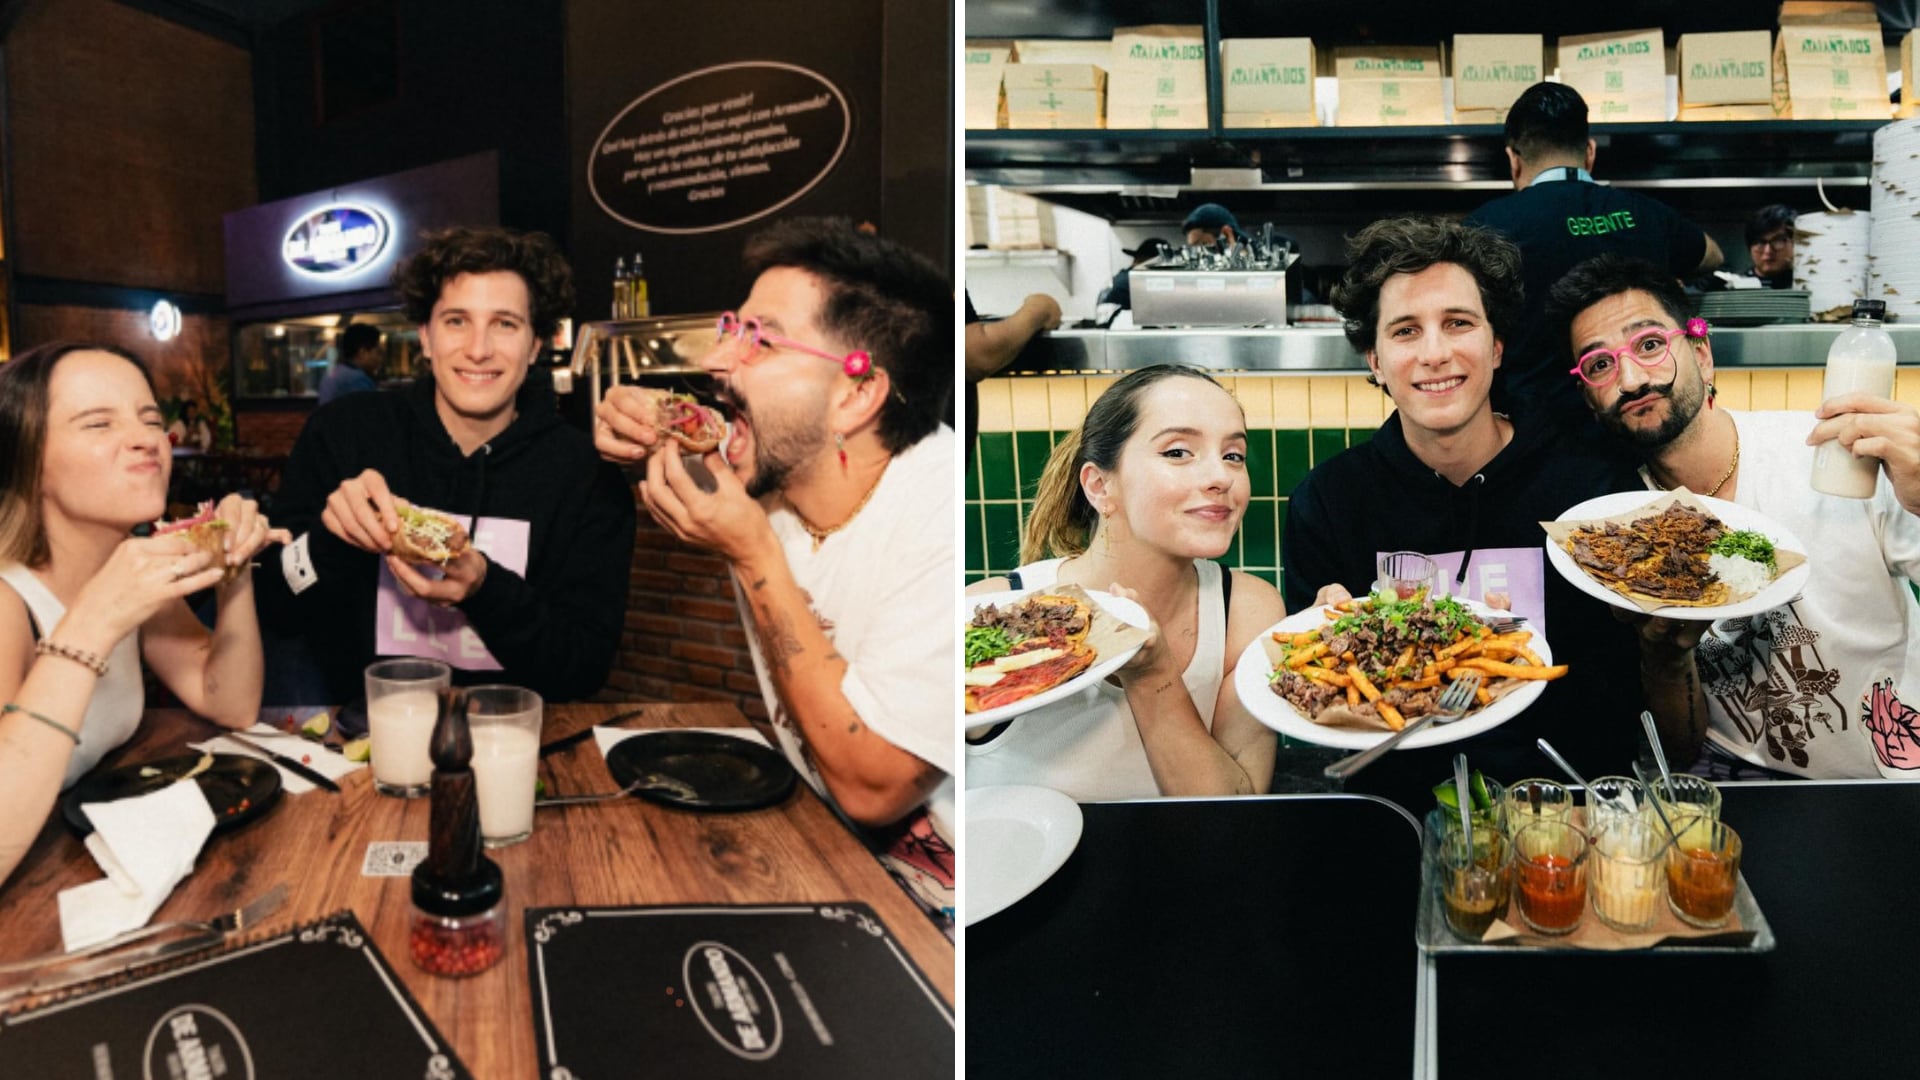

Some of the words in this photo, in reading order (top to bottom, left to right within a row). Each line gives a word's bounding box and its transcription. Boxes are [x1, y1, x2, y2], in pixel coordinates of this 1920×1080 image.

[662, 105, 700, 124] Gracias
[751, 109, 771, 122] con
[687, 185, 725, 202] Gracias
[1567, 211, 1636, 235] GERENTE
